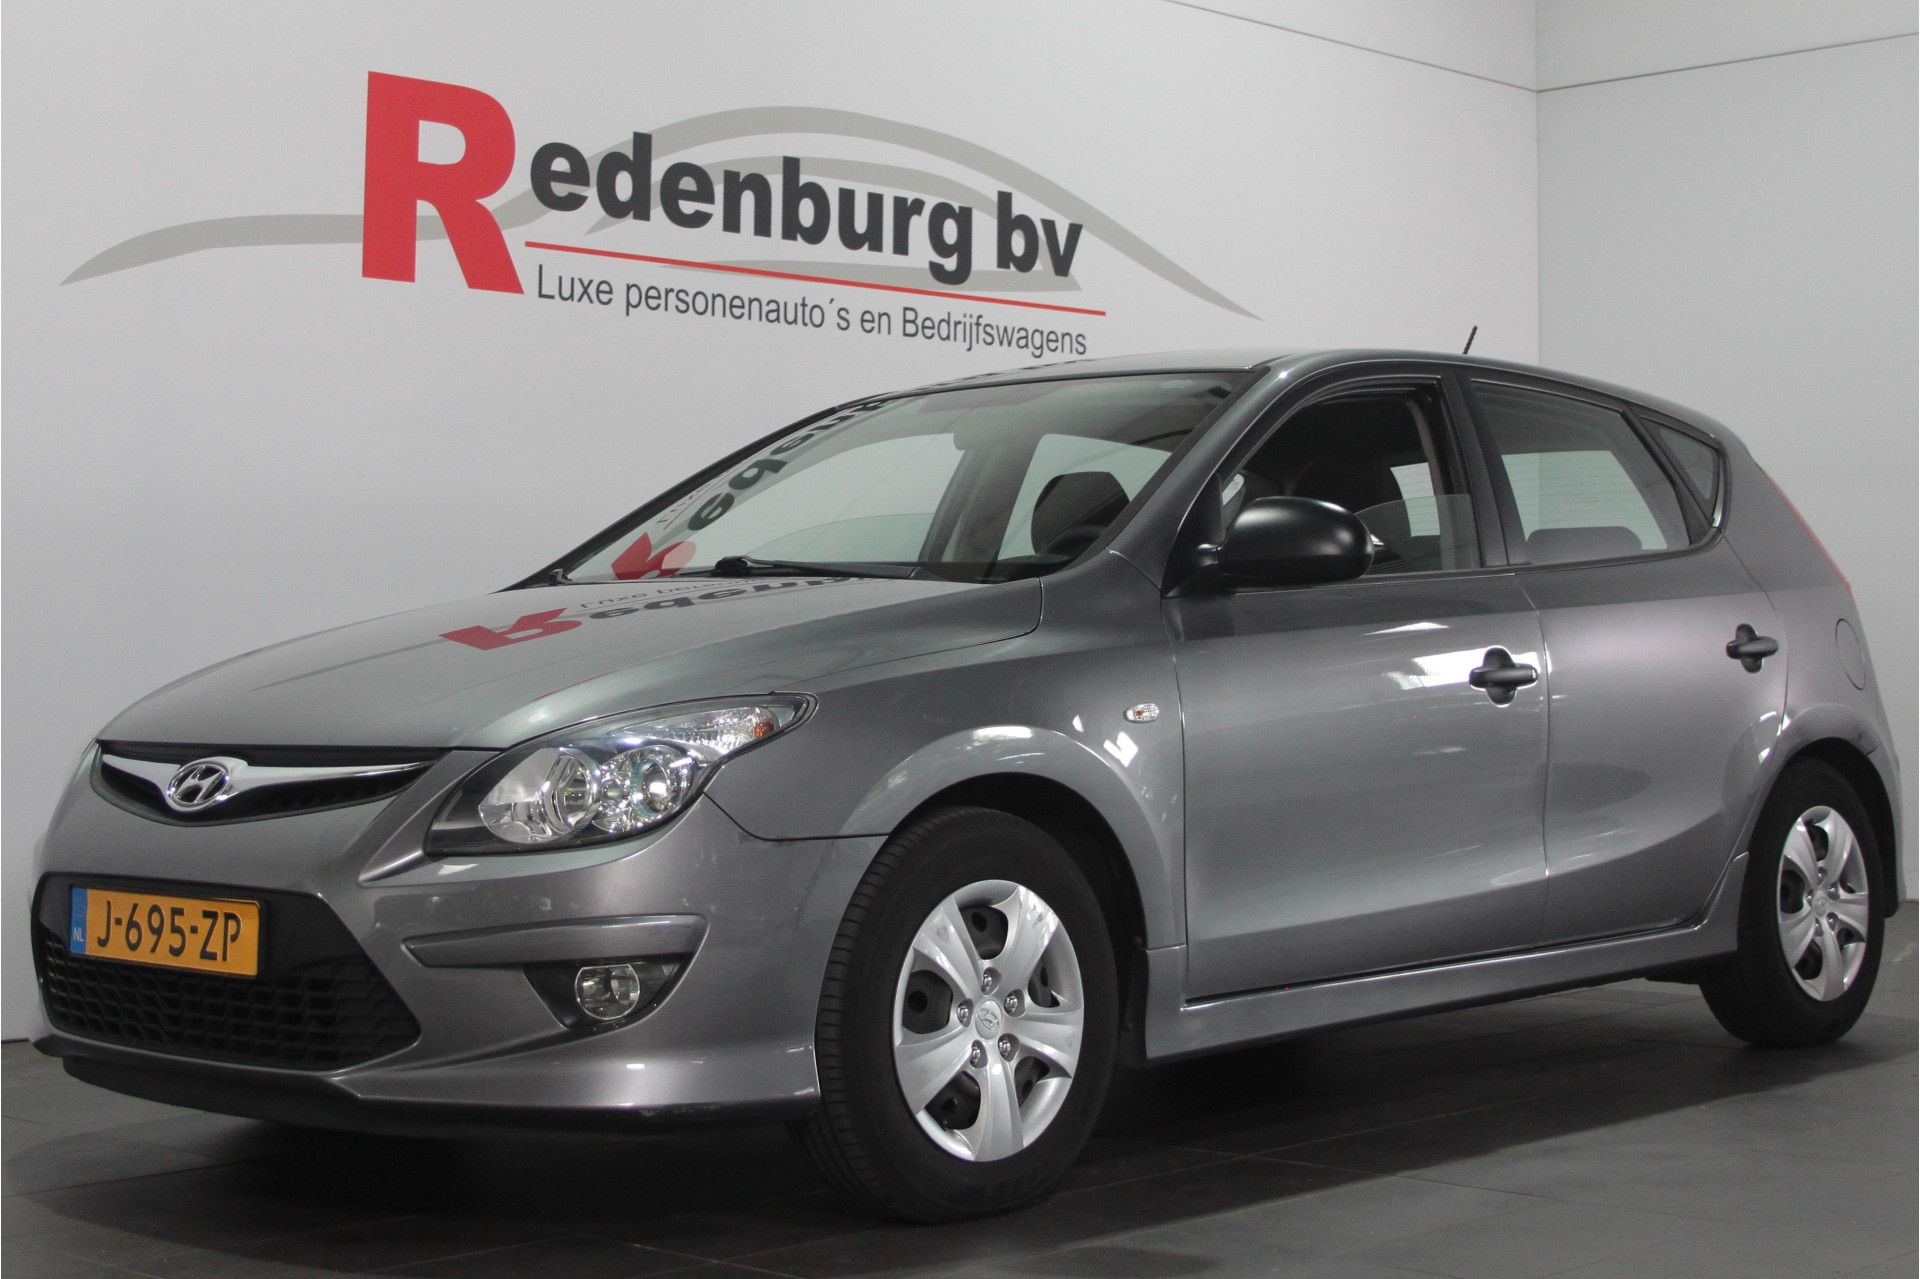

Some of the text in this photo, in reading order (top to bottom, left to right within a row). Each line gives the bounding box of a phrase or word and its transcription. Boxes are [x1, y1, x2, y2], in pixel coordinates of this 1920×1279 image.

[362, 71, 1083, 295] Redenburg bv
[538, 264, 613, 305] Luxe
[860, 310, 891, 335] en
[902, 306, 1087, 358] Bedrijfswagens
[73, 927, 85, 942] NL
[97, 900, 242, 962] J-695-ZP
